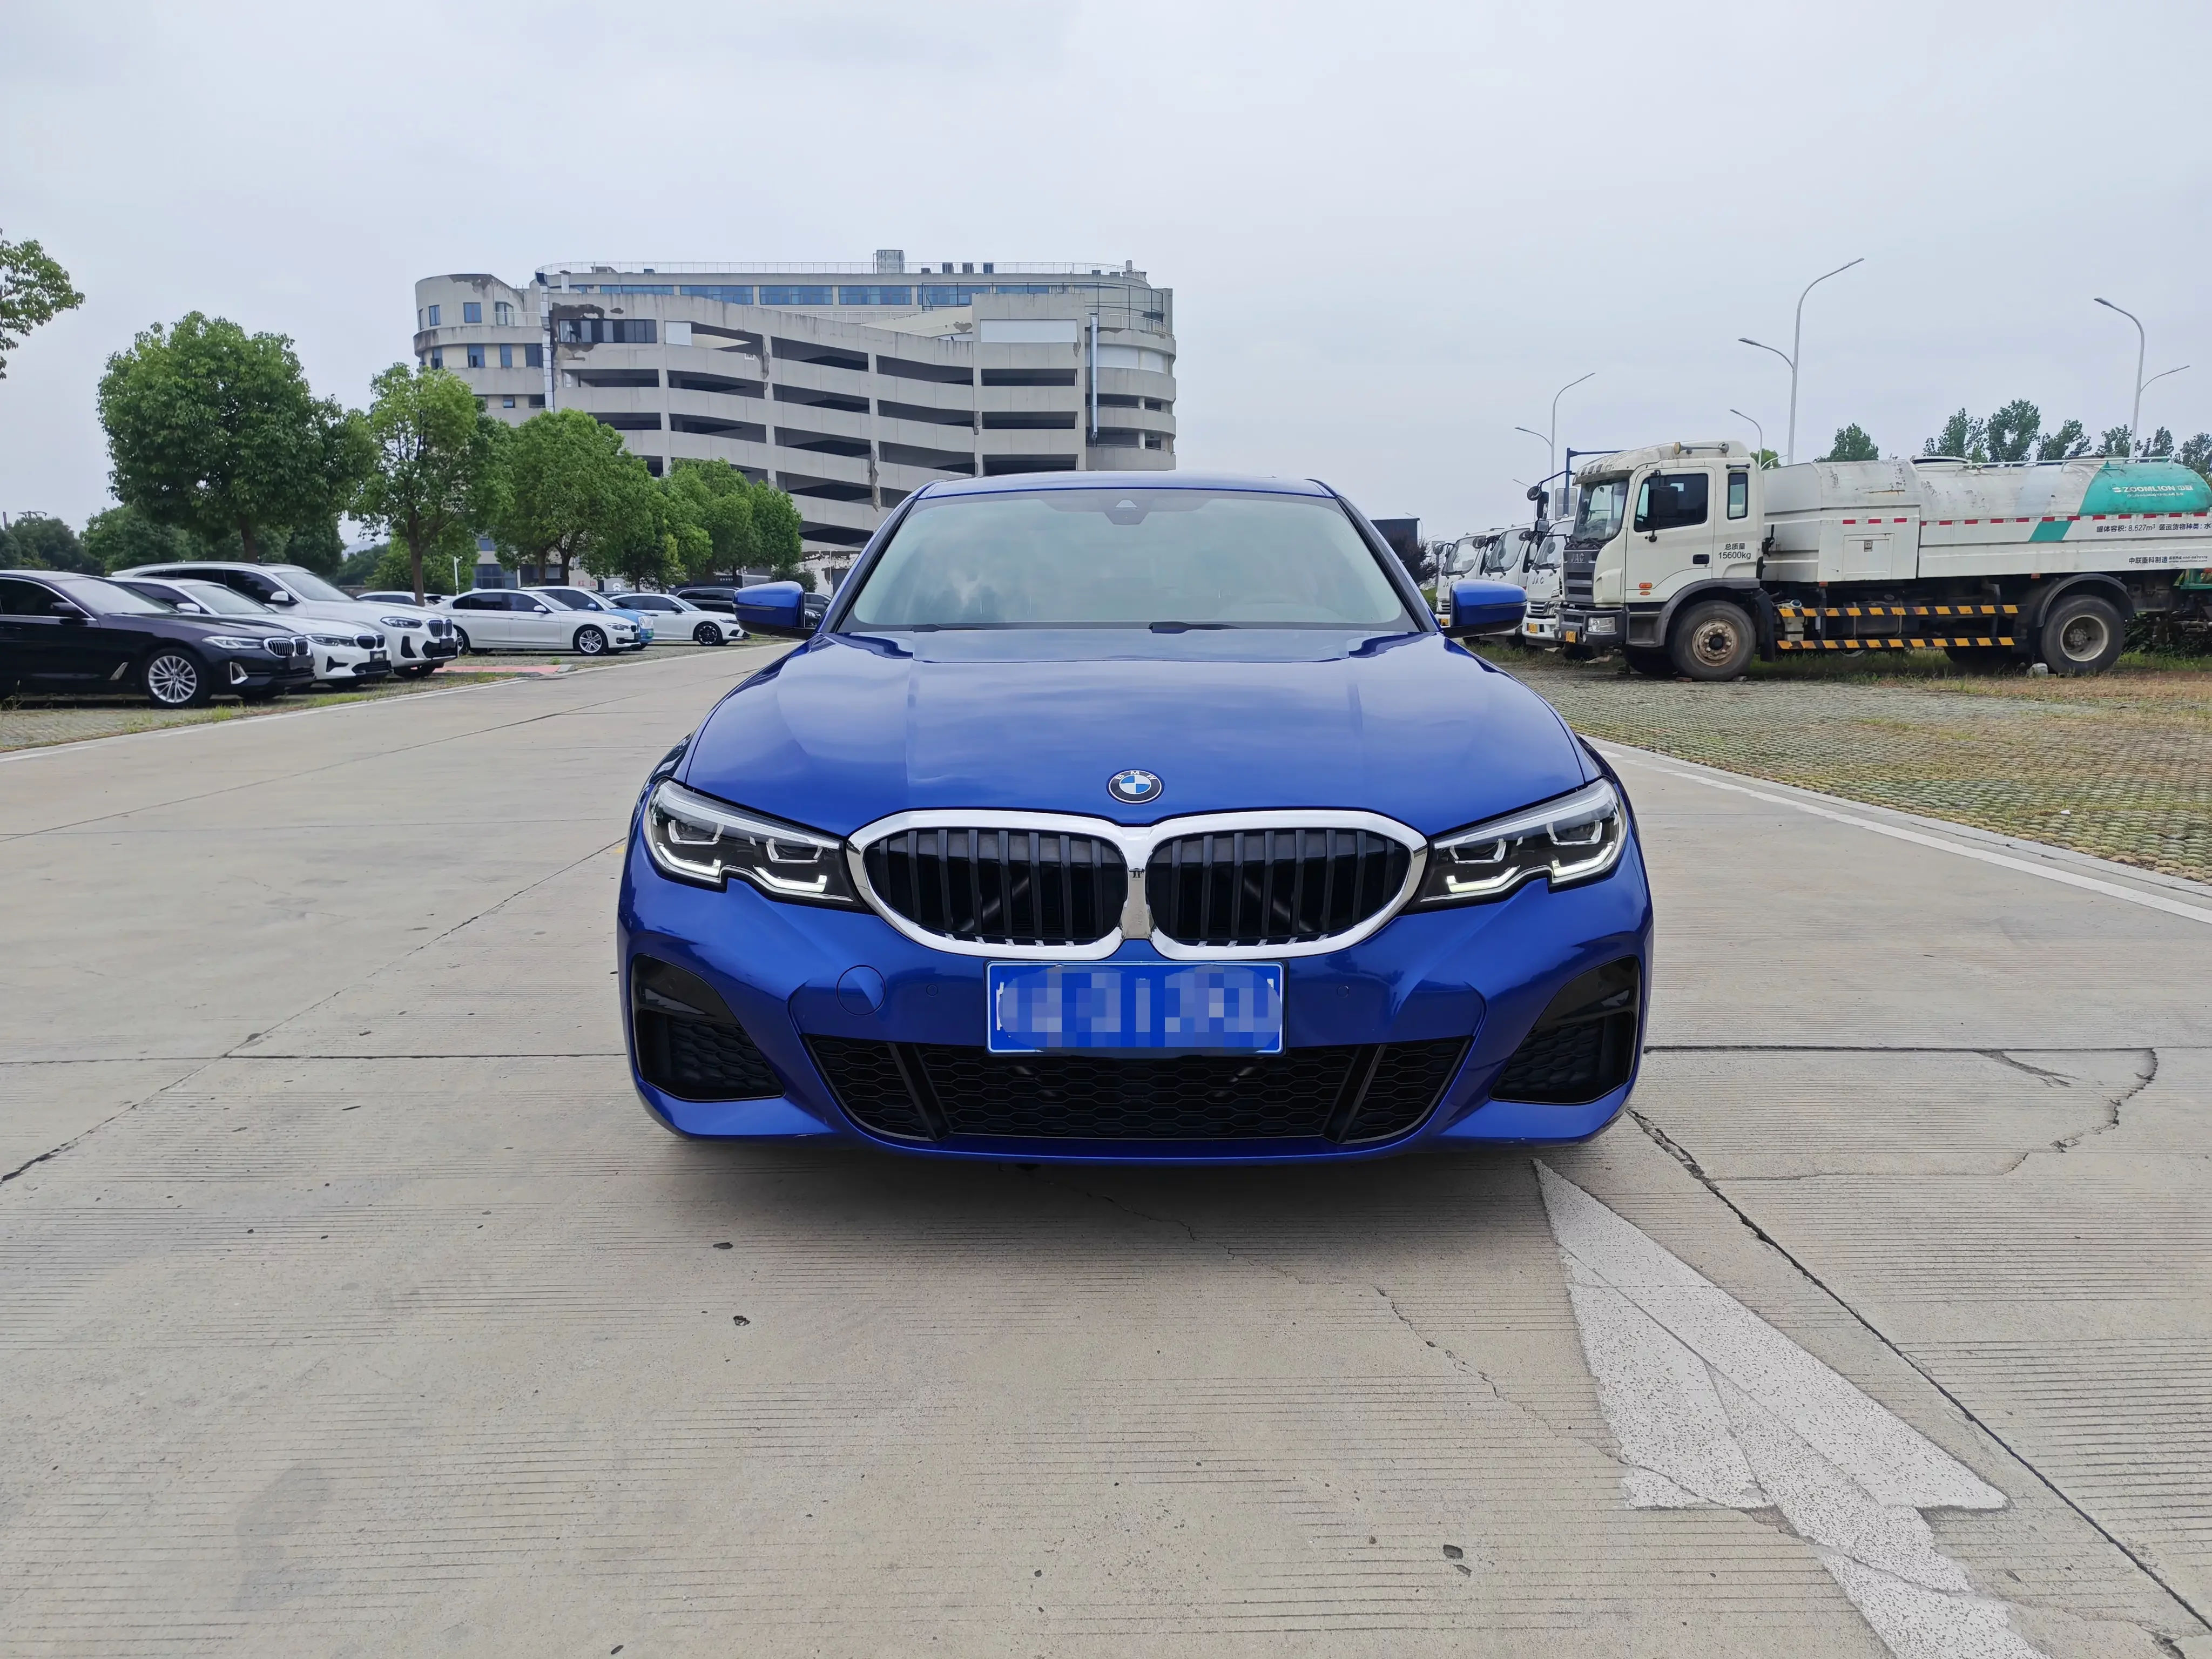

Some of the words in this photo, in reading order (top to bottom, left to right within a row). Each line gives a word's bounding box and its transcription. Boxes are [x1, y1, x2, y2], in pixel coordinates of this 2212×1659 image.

[1571, 552, 1584, 562] JAC
[1718, 551, 1751, 560] 15600kg
[2129, 556, 2168, 564] 中联重科制造
[1532, 576, 1545, 585] JAC
[1115, 771, 1157, 780] BMW
